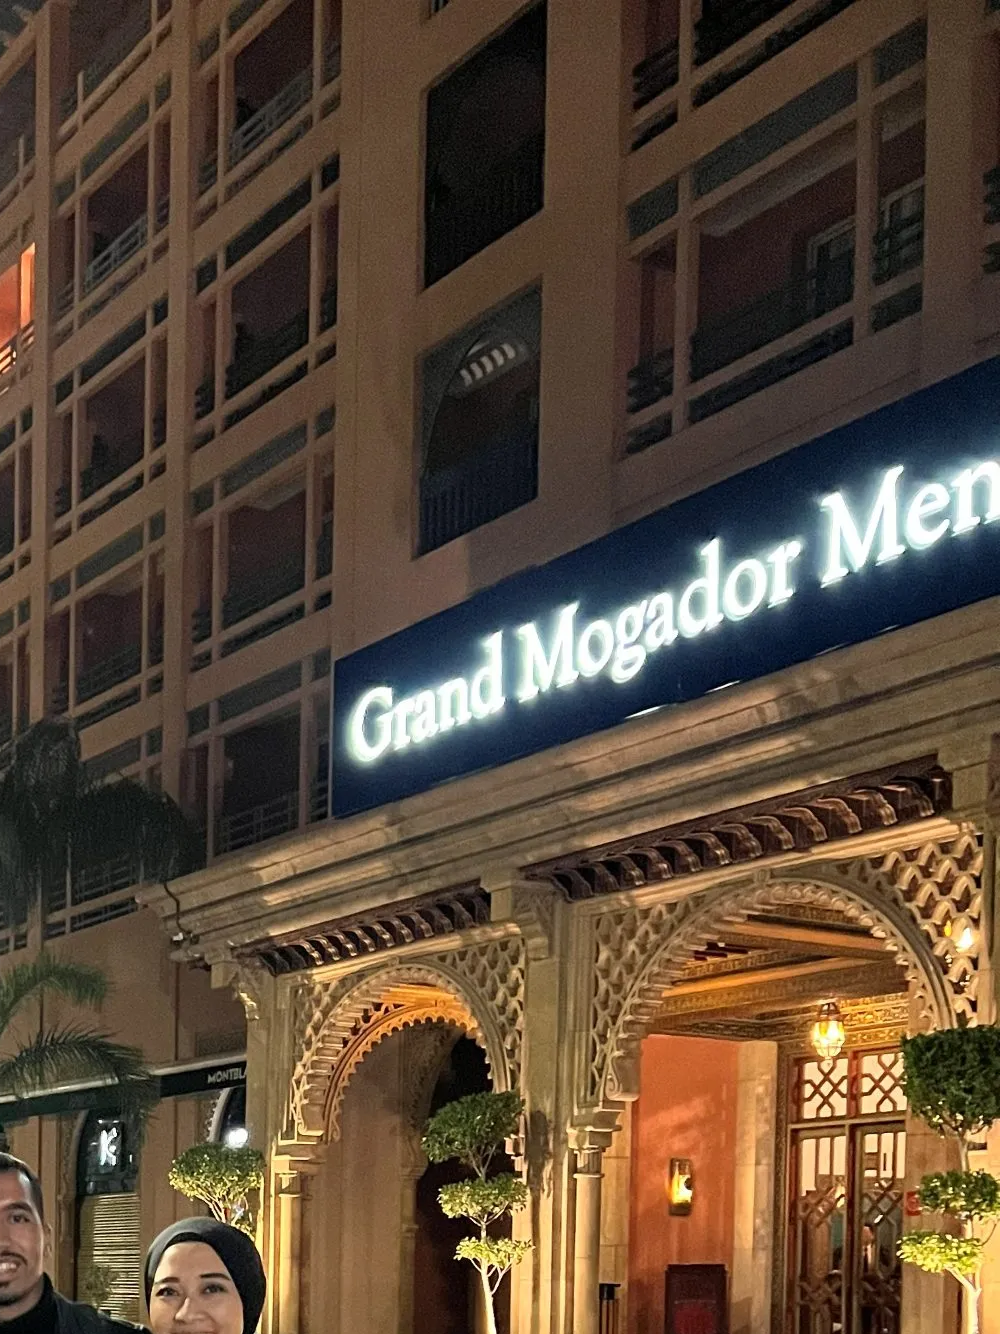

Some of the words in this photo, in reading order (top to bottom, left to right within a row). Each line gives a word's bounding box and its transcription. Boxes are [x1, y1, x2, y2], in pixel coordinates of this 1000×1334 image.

[350, 629, 505, 762] Grand
[517, 537, 802, 703] Mogador
[819, 461, 1000, 589] Men
